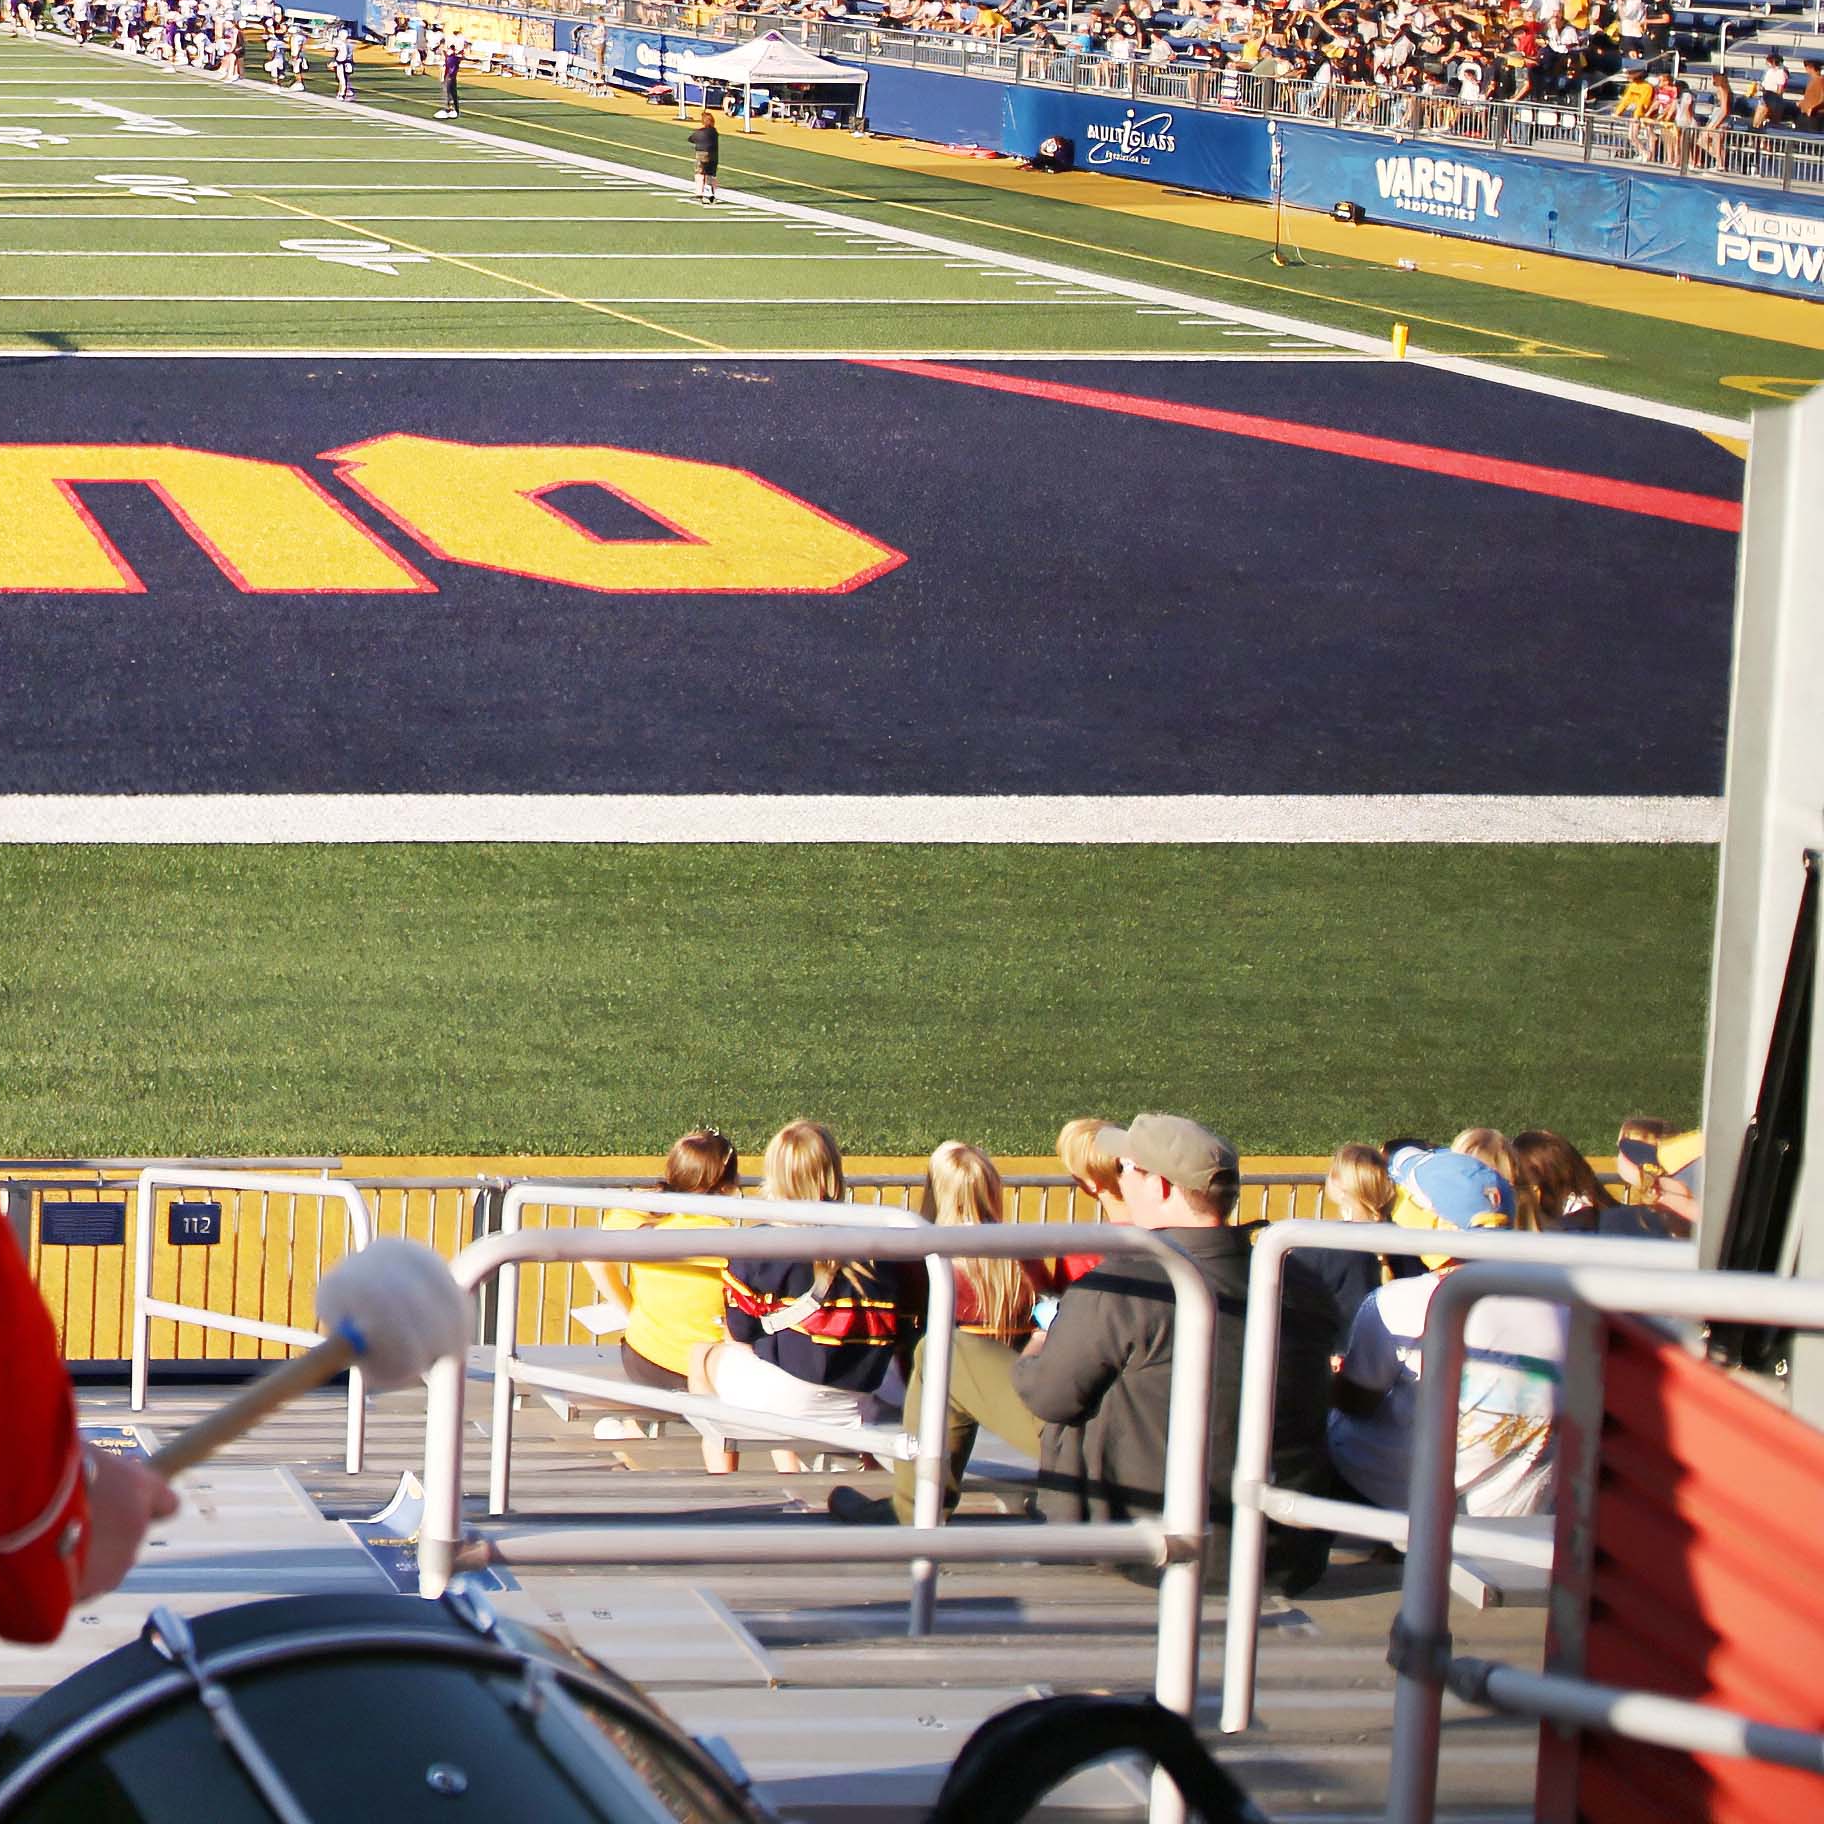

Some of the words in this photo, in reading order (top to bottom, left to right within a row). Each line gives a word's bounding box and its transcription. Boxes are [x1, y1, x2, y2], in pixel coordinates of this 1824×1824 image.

[94, 174, 232, 198] 20
[1375, 156, 1504, 218] VARSITY
[1395, 197, 1476, 222] PROPERTIES
[279, 239, 432, 264] 10
[1716, 233, 1824, 283] POW
[183, 1216, 211, 1234] 112
